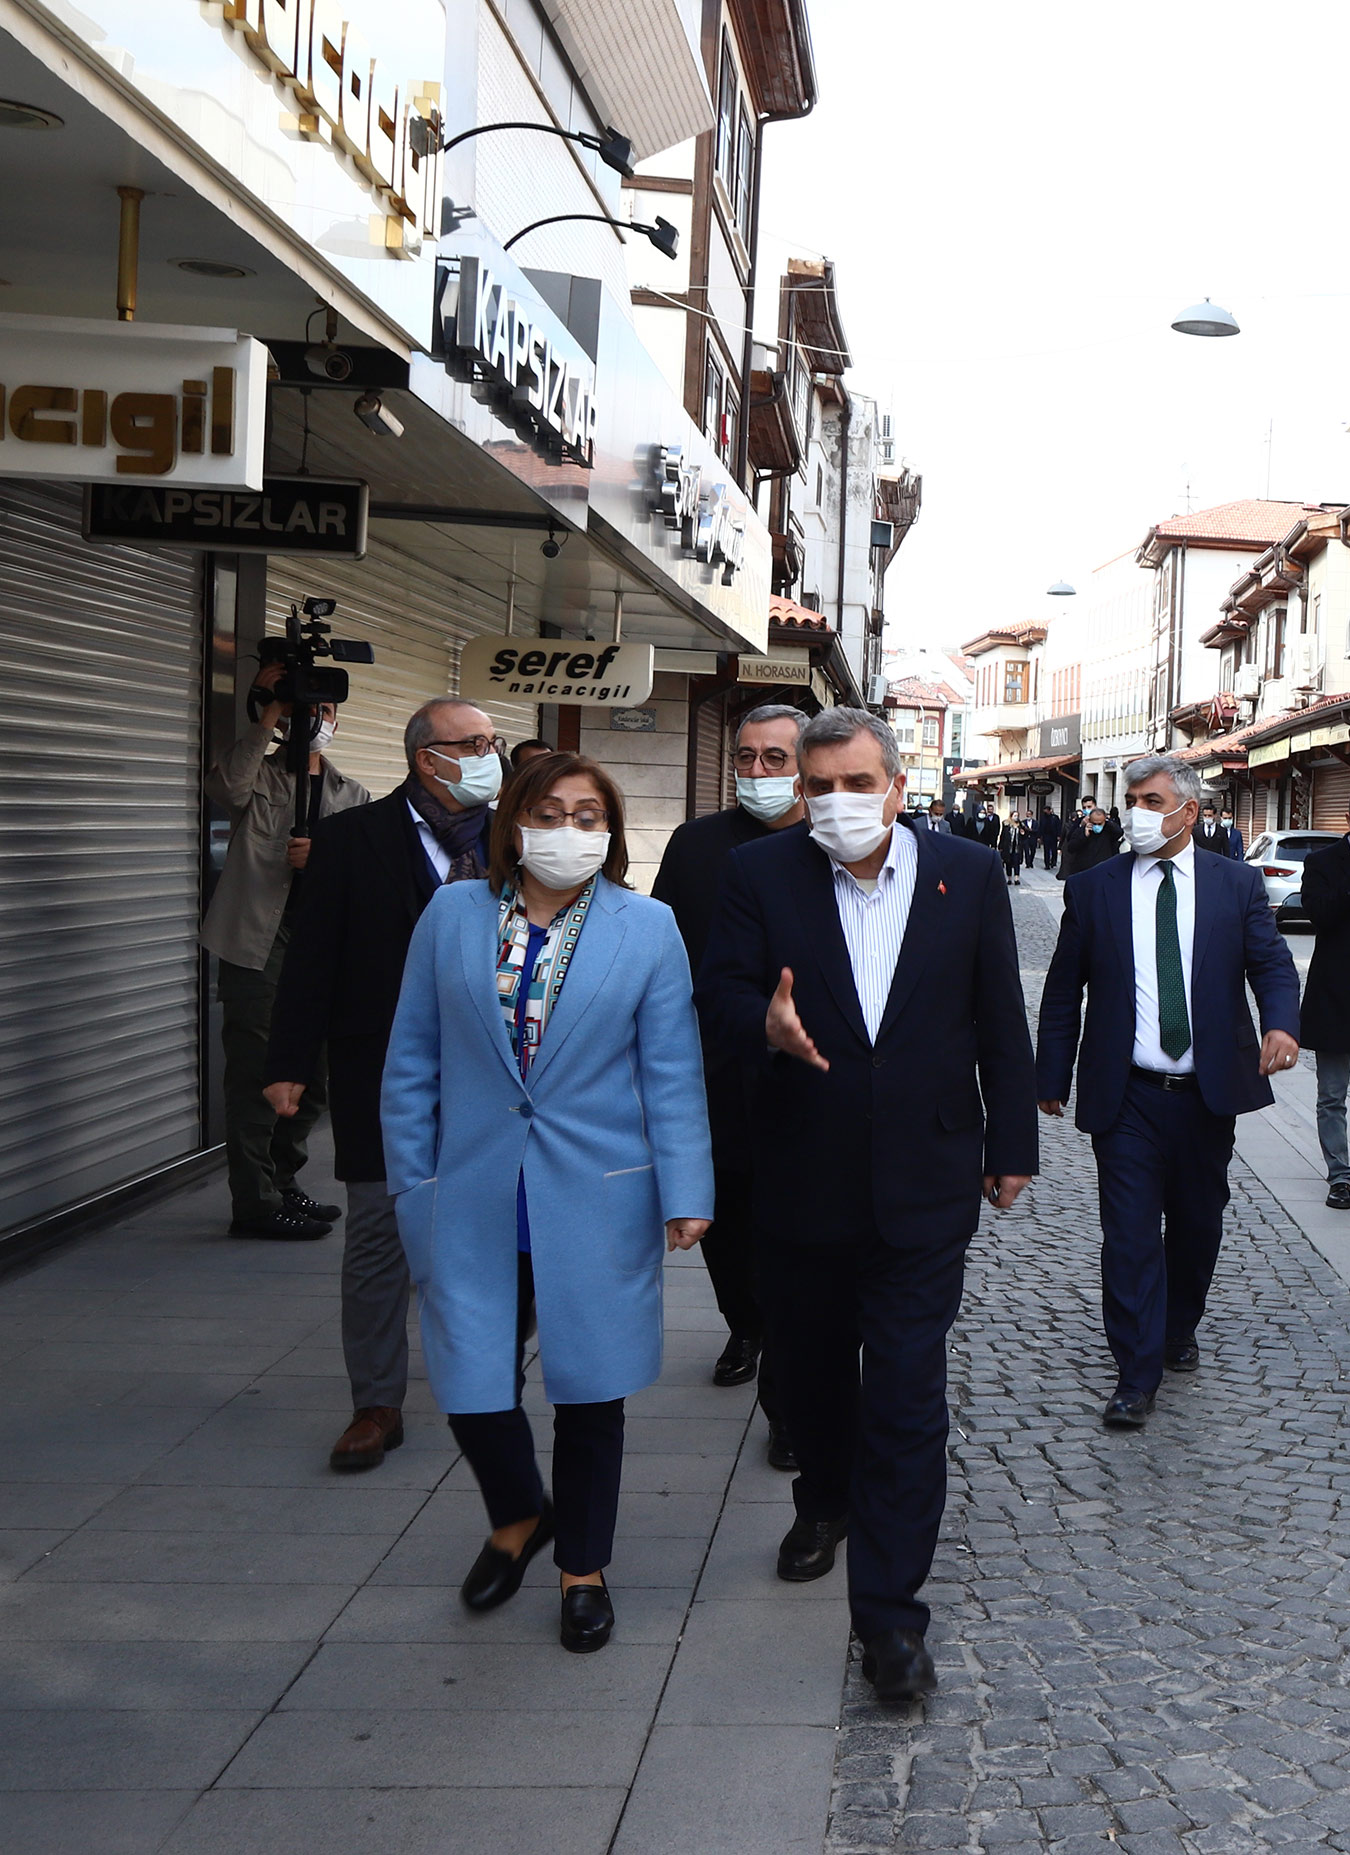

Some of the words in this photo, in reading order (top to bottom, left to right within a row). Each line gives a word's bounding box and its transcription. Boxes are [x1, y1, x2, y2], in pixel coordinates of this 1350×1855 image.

[0, 366, 237, 475] cıgil
[102, 484, 347, 535] KAPSIZLAR
[742, 663, 753, 676] N.
[755, 665, 806, 680] HORASAN
